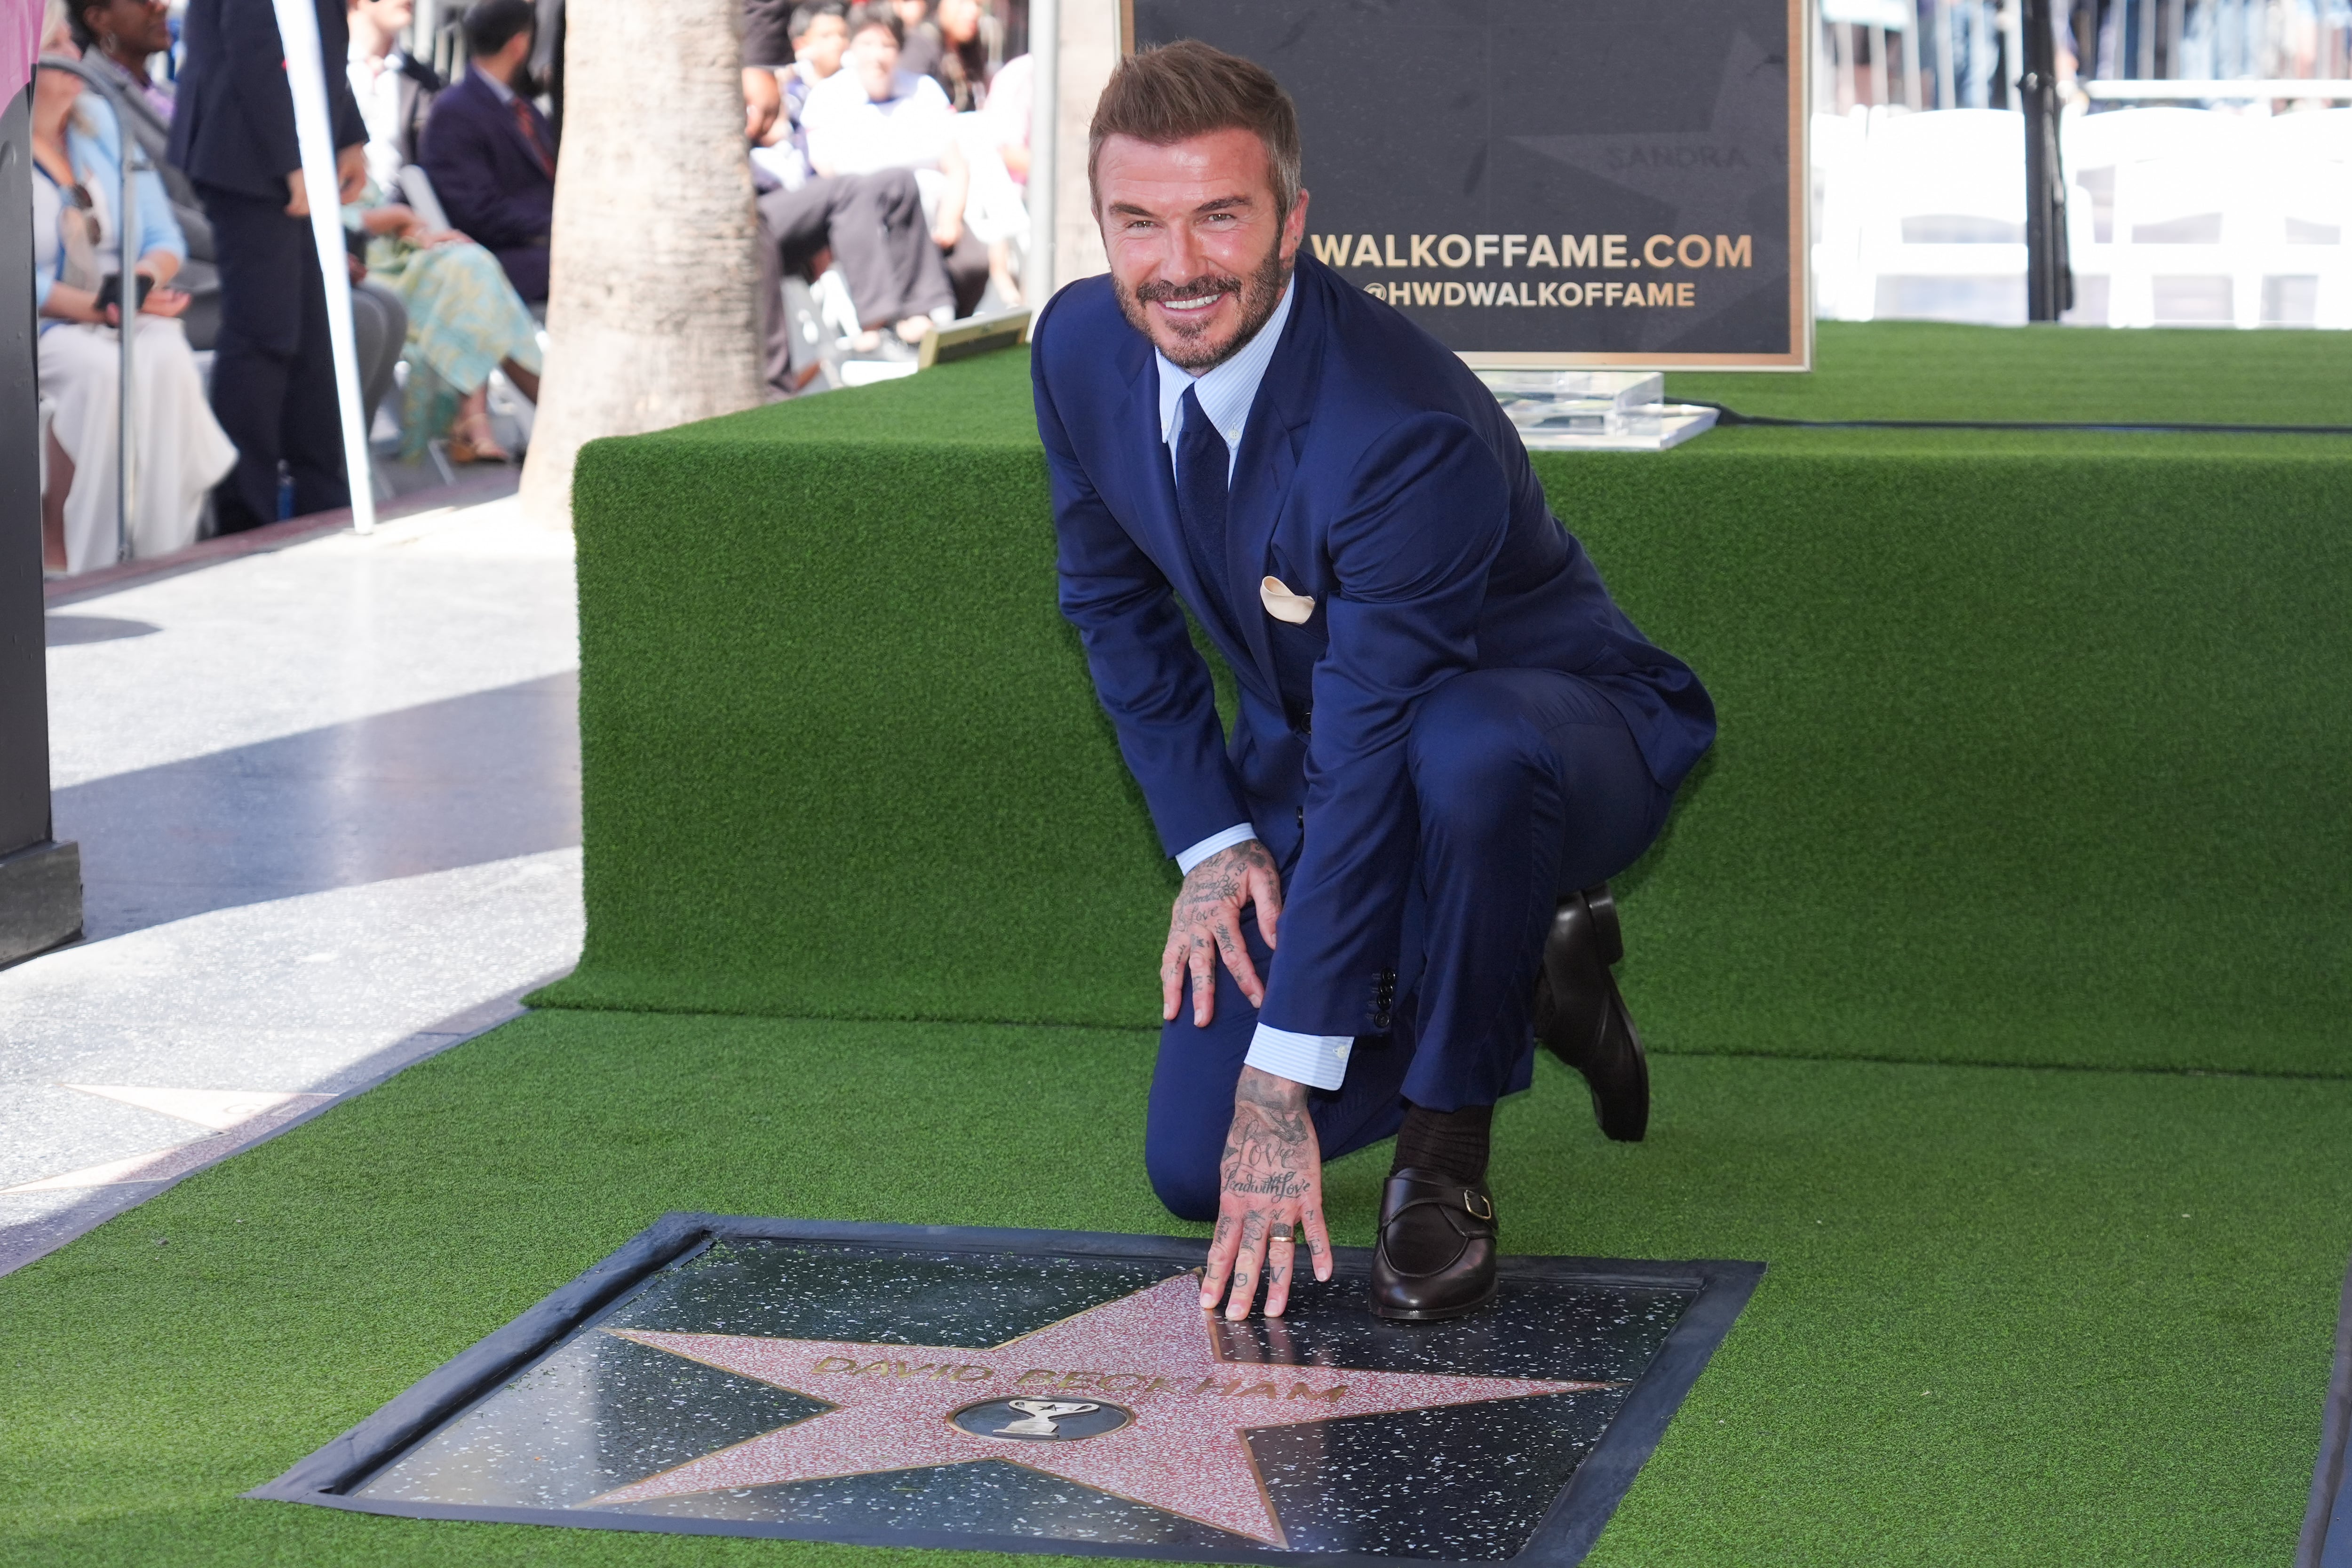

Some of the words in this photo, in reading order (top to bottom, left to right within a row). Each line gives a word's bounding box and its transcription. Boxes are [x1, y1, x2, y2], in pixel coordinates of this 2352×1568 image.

[1605, 144, 1750, 170] SANDRA
[1310, 233, 1752, 268] WALKOFFAME.COM
[1363, 281, 1696, 307] @HWDWALKOFFAME
[811, 1355, 994, 1381] DAVID
[1015, 1369, 1348, 1402] BECKHAM
